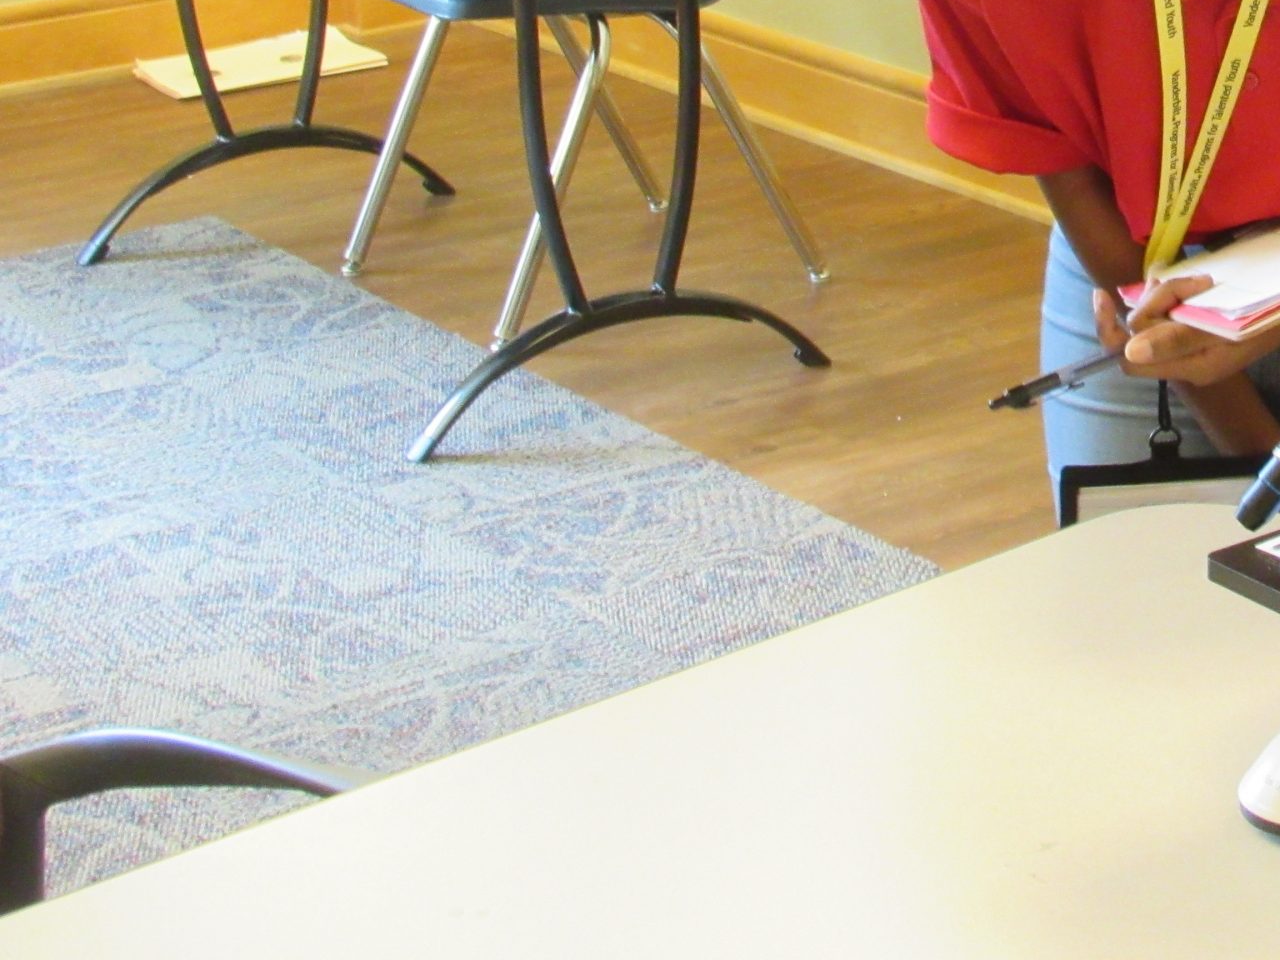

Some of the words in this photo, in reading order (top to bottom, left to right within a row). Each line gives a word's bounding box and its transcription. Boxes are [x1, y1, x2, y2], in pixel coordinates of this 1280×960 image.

[1165, 10, 1178, 39] Youth
[1225, 57, 1242, 83] Youth
[1211, 84, 1233, 123] Talented
[1206, 121, 1219, 137] for
[1194, 134, 1214, 176] Programs
